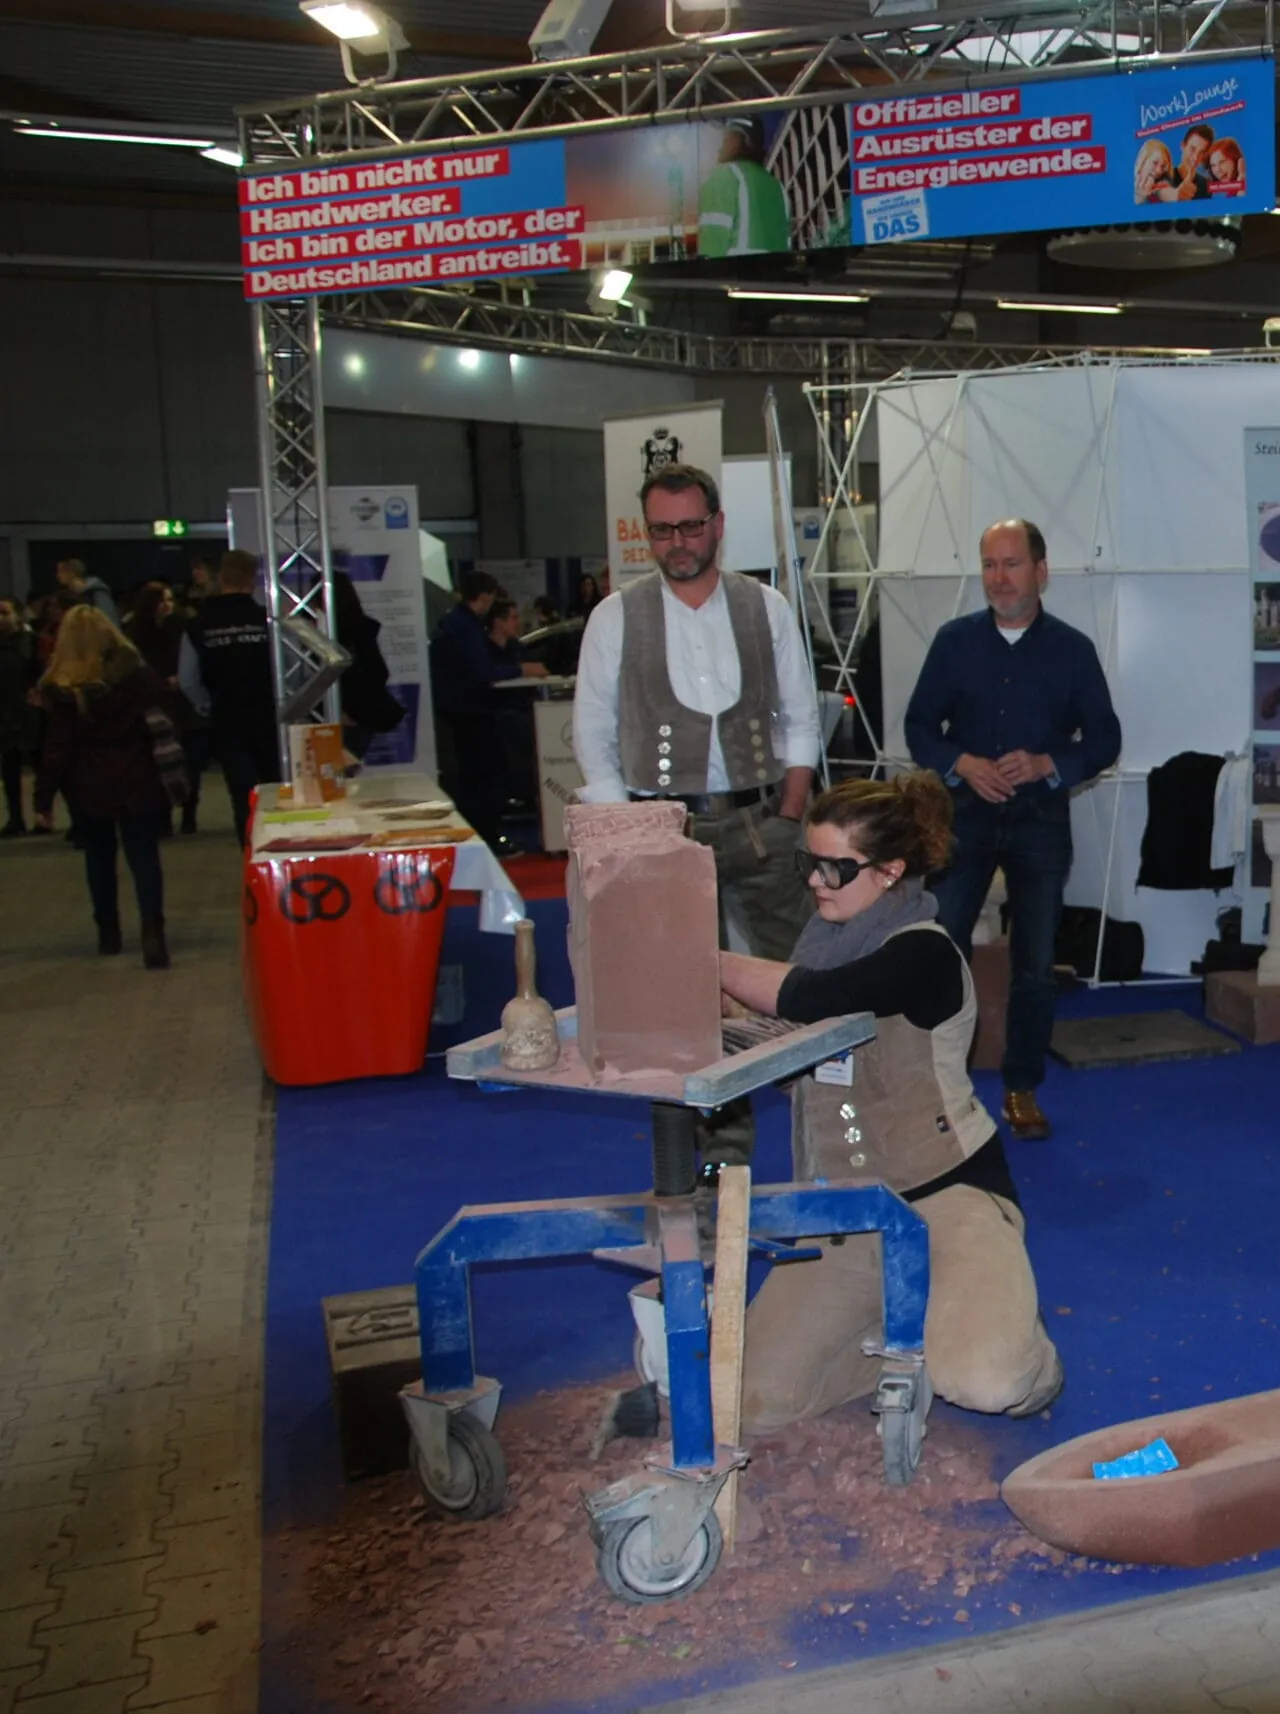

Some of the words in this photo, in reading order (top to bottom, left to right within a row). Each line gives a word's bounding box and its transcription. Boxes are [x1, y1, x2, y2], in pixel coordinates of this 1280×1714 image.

[856, 90, 1016, 126] Offizieller
[857, 124, 1021, 159] Ausrüster
[1030, 117, 1087, 142] der
[248, 174, 295, 201] Ich
[301, 169, 349, 195] bin
[356, 158, 437, 189] nicht
[443, 153, 500, 178] nur
[858, 148, 1102, 190] Energiewende.
[250, 193, 452, 233] Handwerker.
[874, 214, 919, 241] DAS
[249, 237, 295, 263] Ich
[301, 233, 349, 258] bin
[355, 228, 408, 252] der
[413, 217, 519, 246] Motor,
[524, 208, 581, 233] der
[251, 254, 433, 293] Deutschland
[439, 242, 571, 276] antreibt.
[617, 518, 648, 542] BA
